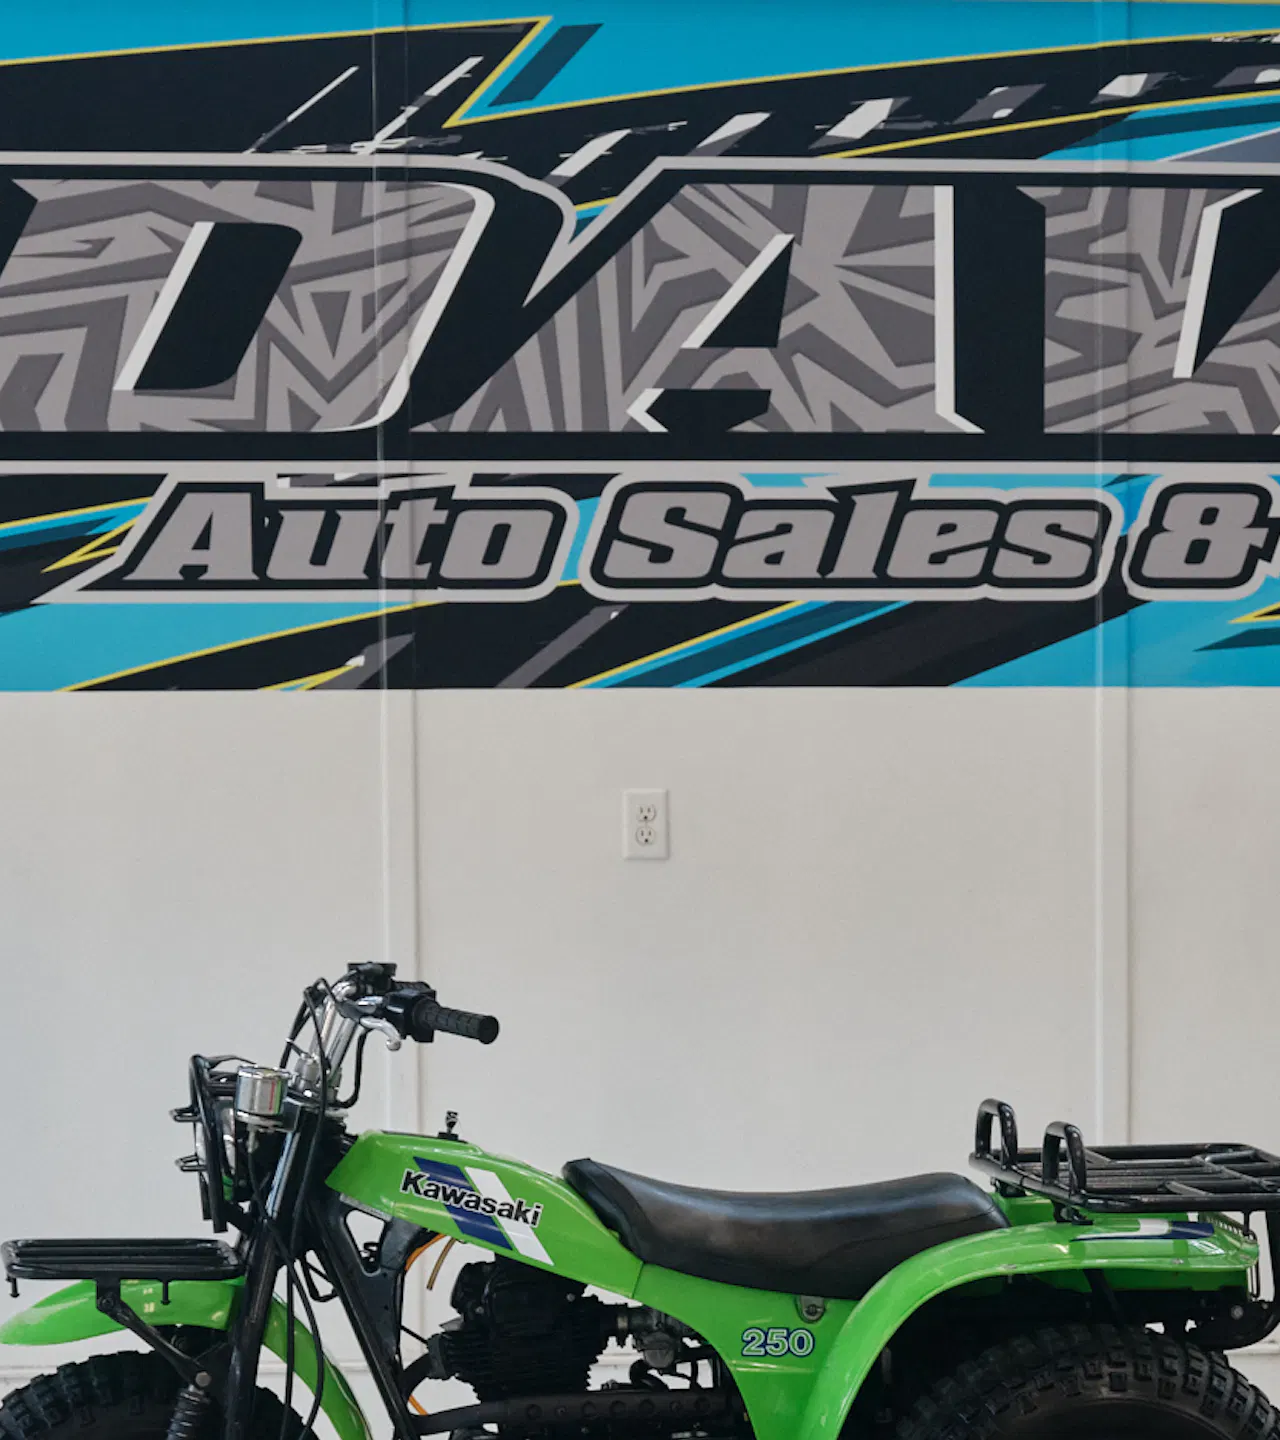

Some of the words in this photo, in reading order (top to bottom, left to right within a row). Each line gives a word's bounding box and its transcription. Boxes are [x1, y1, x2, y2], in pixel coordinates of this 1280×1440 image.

[121, 489, 555, 581] Auto
[602, 488, 1103, 580] Sales
[1139, 490, 1271, 580] &
[400, 1168, 545, 1229] Kawasaki
[741, 1327, 816, 1357] 250
